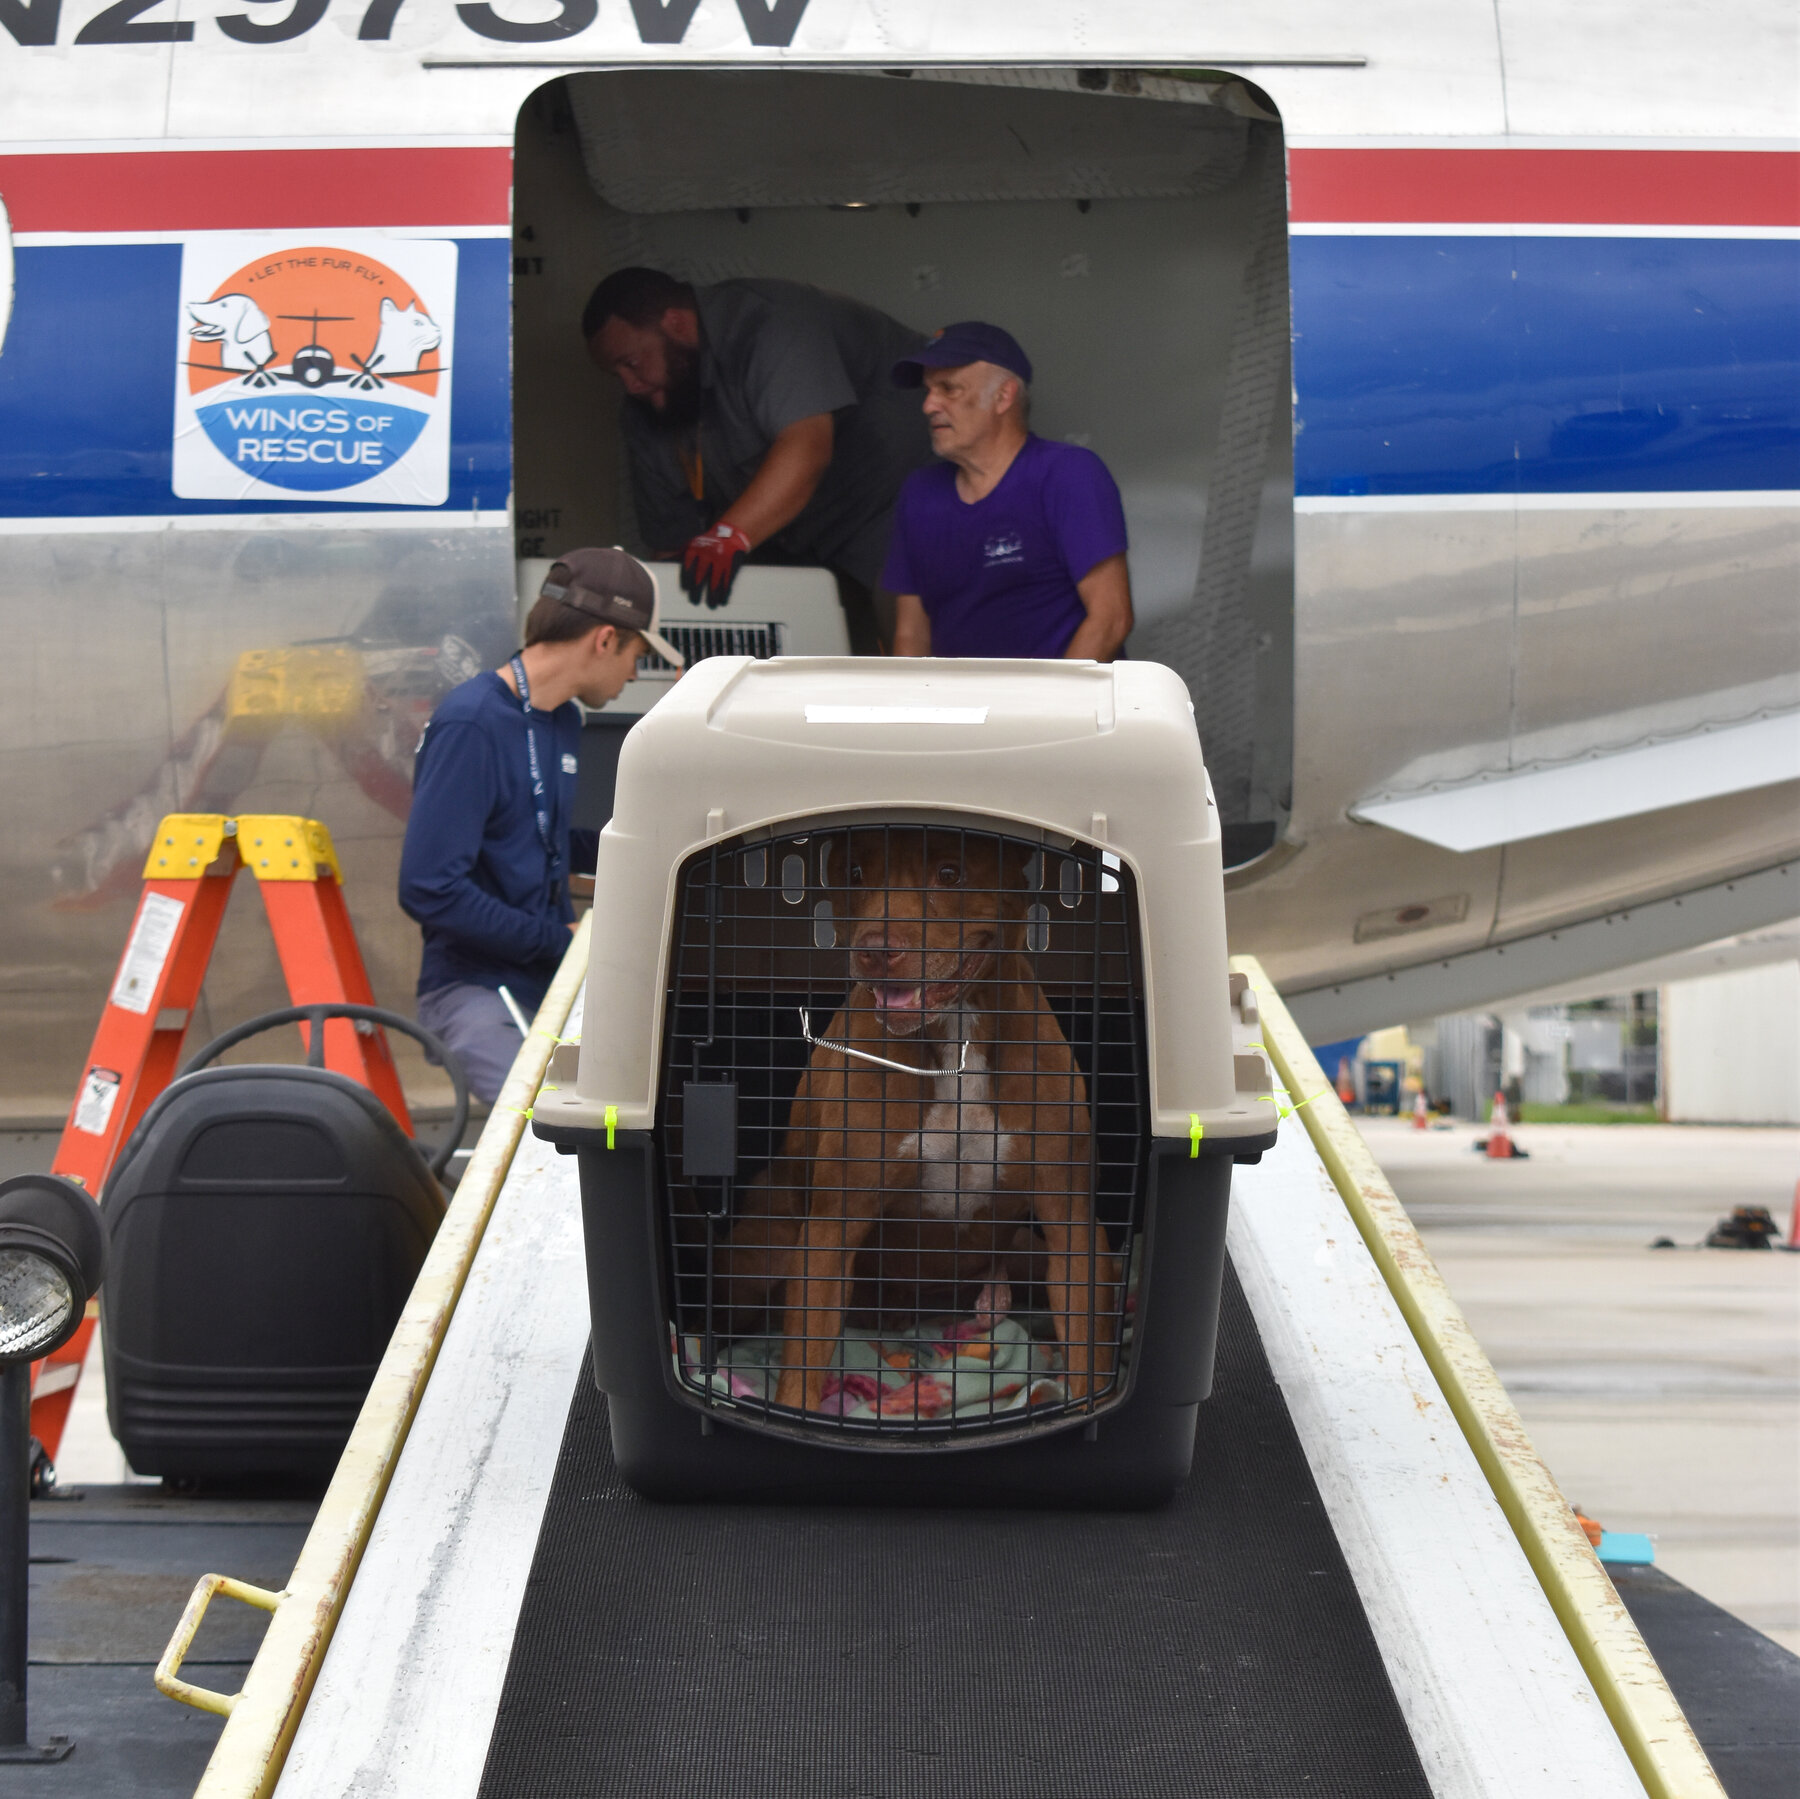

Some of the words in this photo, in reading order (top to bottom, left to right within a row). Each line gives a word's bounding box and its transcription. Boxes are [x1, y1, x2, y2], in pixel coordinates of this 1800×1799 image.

[254, 262, 283, 280] LET
[287, 257, 317, 269] THE
[321, 257, 352, 271] FUR
[354, 265, 381, 282] FLY
[225, 408, 350, 433] WINGS
[355, 415, 394, 432] OF
[237, 438, 383, 466] RESCUE
